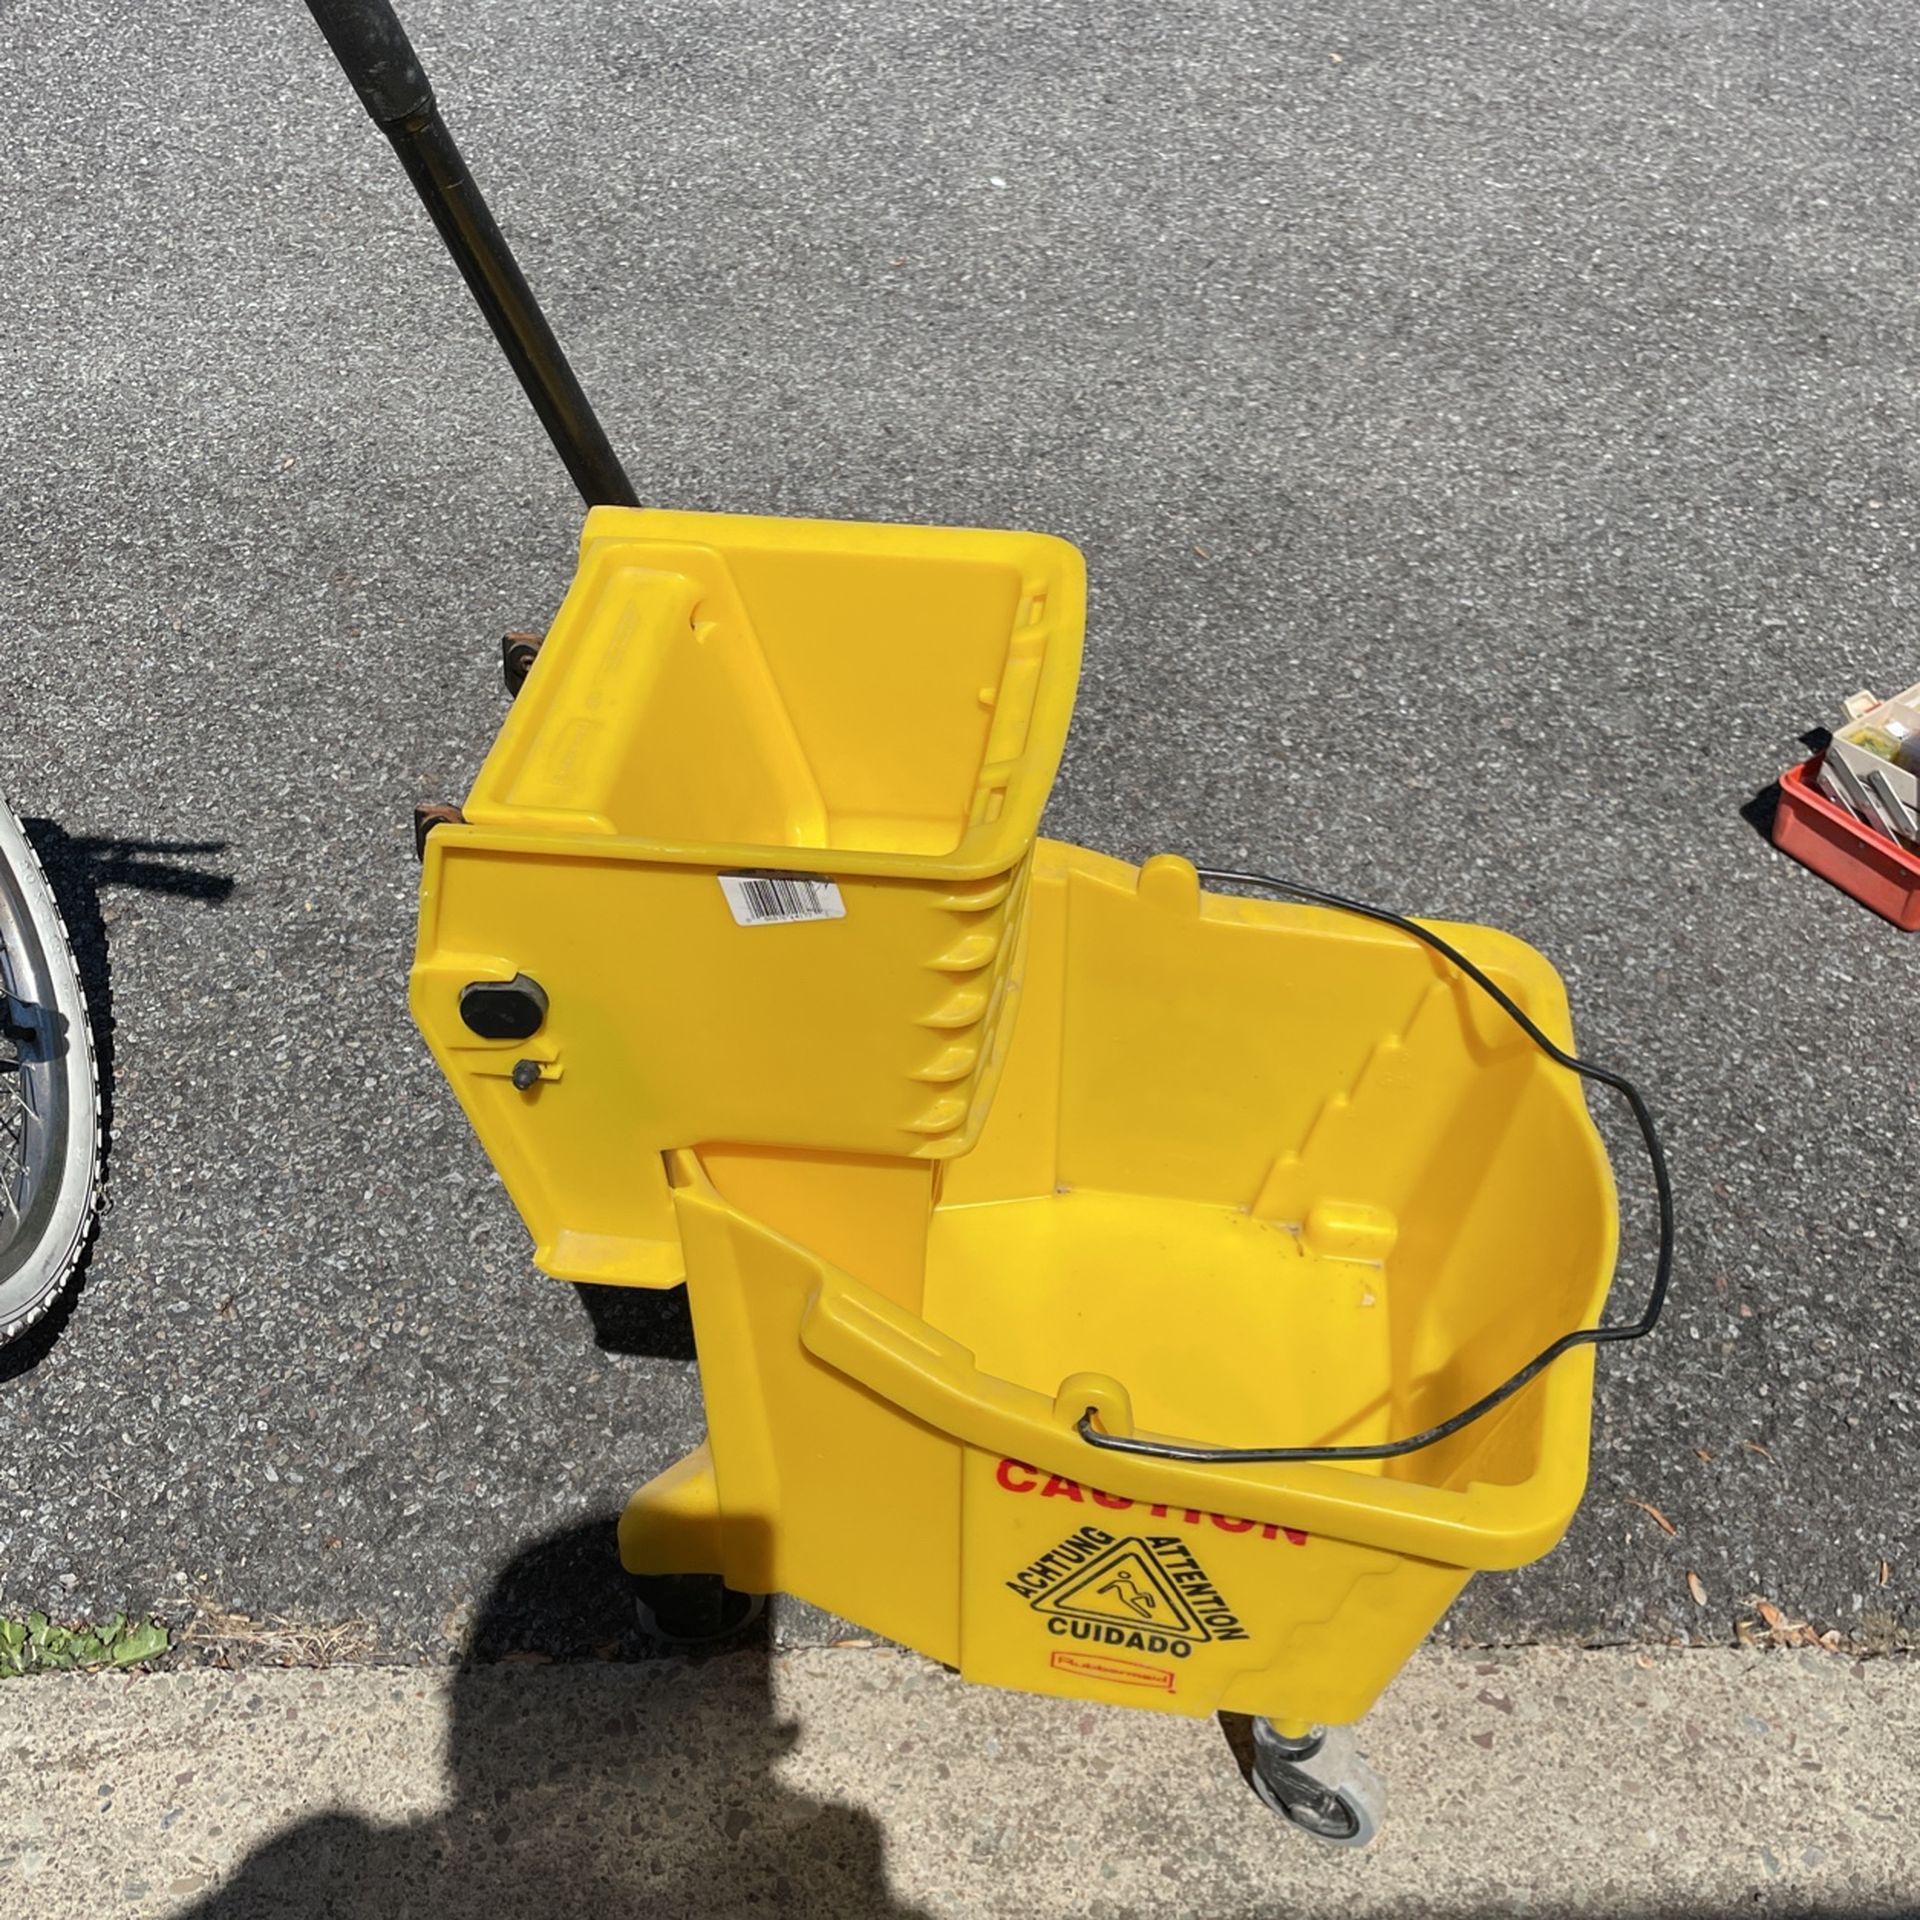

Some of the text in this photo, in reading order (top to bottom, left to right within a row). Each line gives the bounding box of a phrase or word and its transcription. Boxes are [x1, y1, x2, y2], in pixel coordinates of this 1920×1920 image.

[1005, 1526, 1116, 1599] ACHTUNG
[1145, 1536, 1250, 1641] ATTENTION
[1047, 1616, 1192, 1659] CUIDADO
